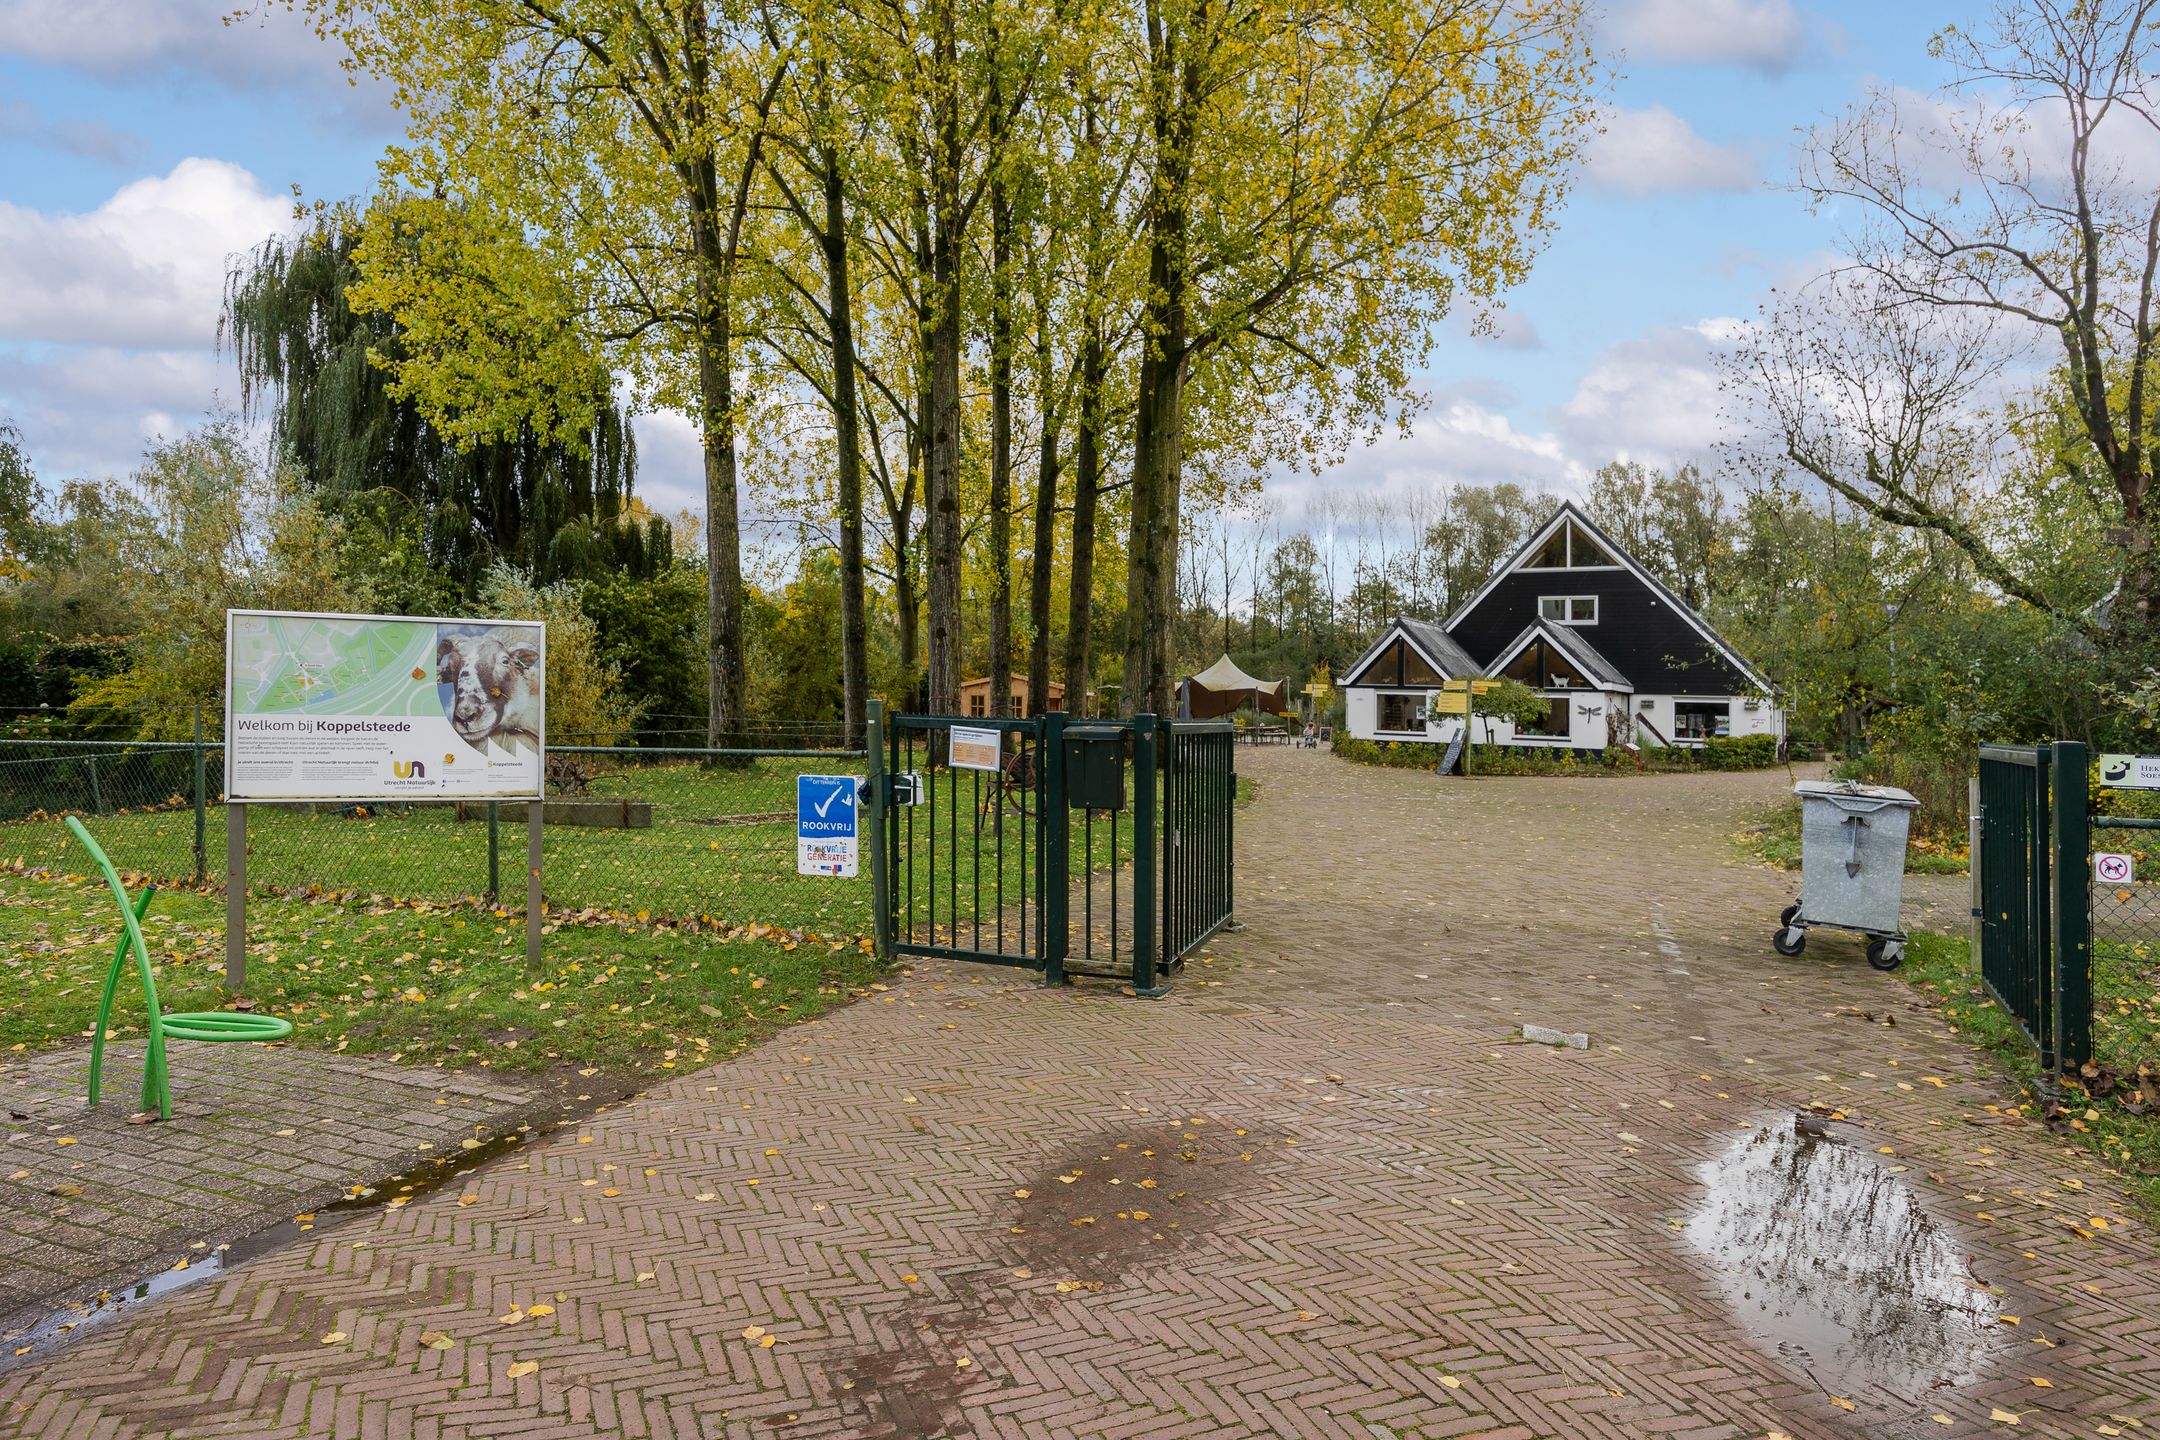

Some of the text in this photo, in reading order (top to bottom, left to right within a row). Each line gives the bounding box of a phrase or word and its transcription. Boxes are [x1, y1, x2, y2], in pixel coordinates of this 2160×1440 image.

[238, 719, 412, 734] Welkom bij Koppelsteede
[802, 821, 852, 831] ROOKVRIJ
[807, 853, 847, 862] GENERATIE
